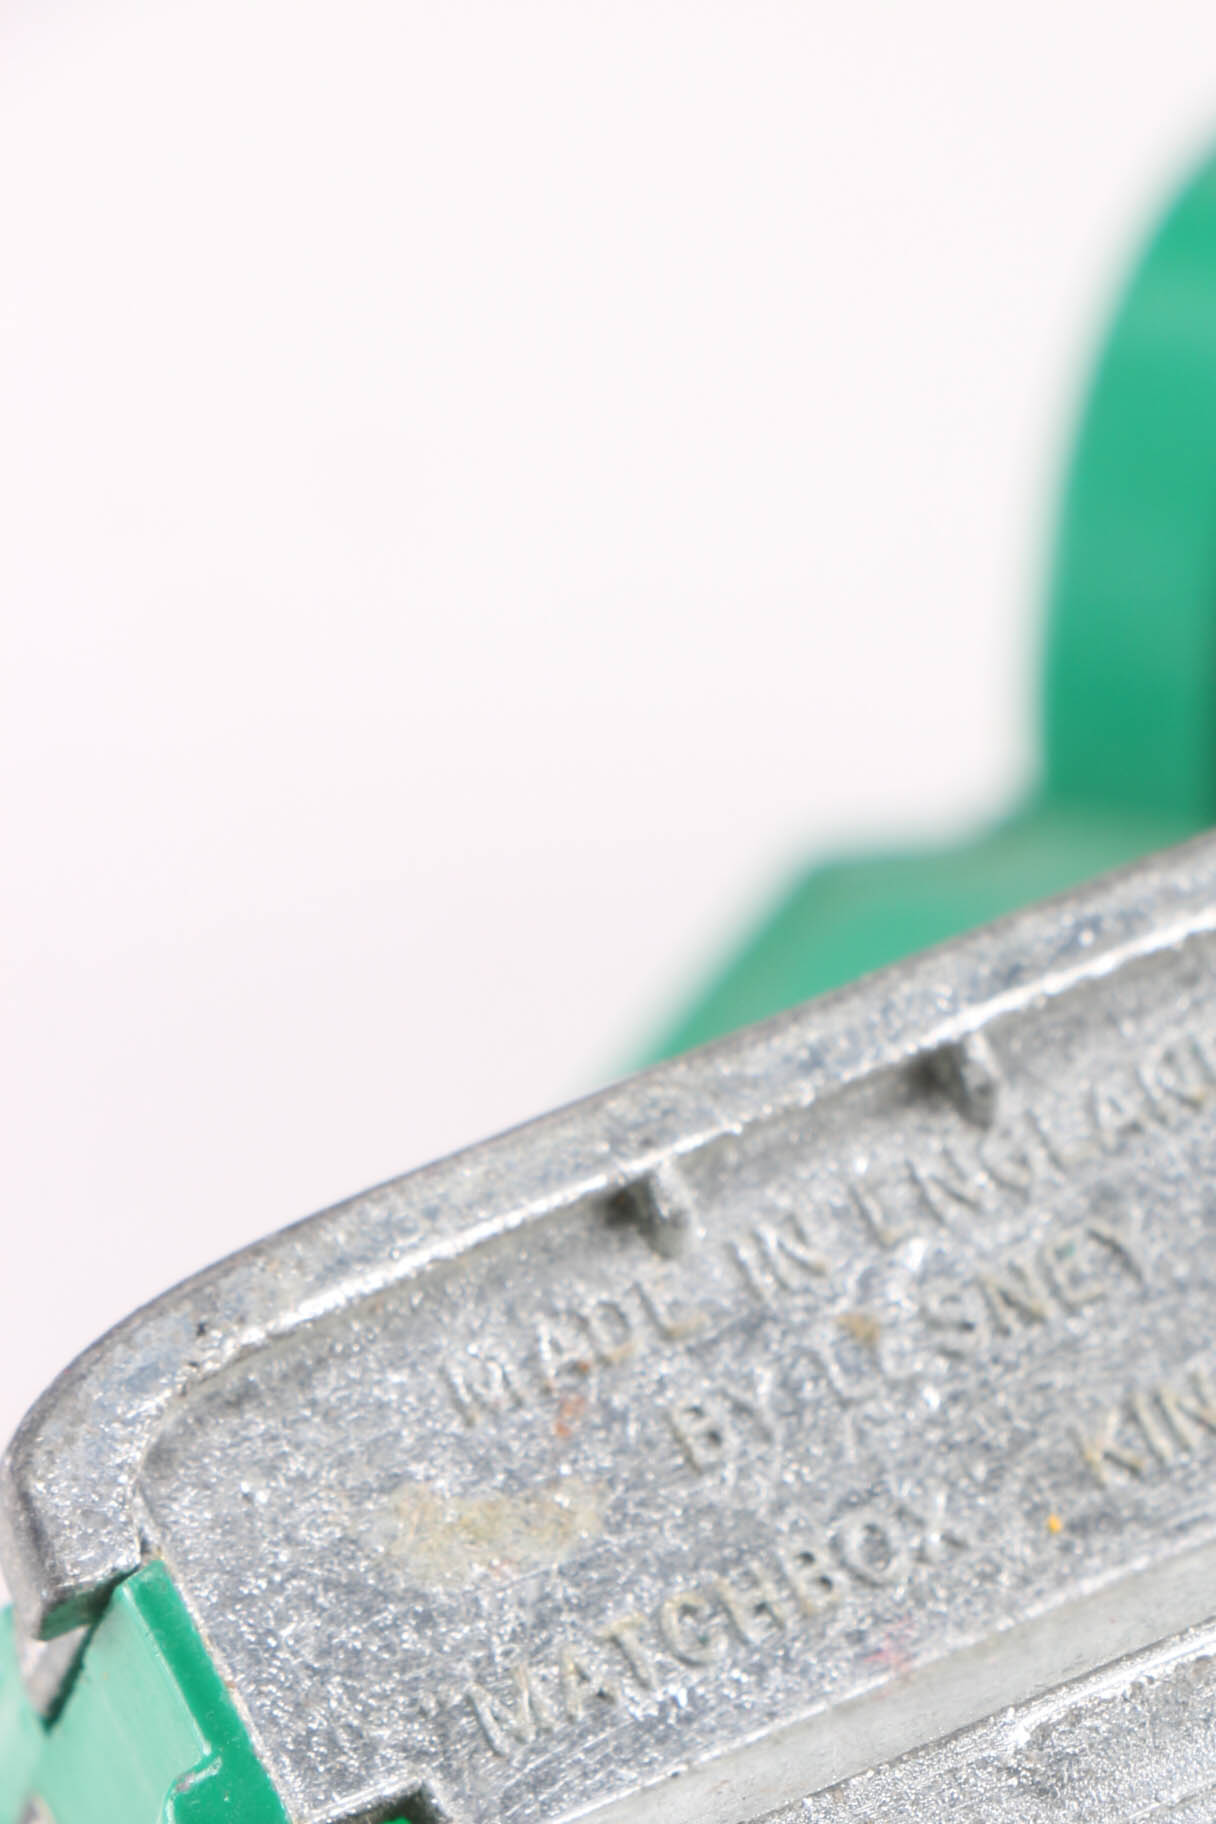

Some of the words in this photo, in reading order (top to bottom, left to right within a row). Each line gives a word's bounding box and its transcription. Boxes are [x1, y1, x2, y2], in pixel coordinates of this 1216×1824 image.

[664, 1362, 778, 1475] BY
[811, 1203, 1146, 1410] LESNEY
[726, 1212, 832, 1306] IN
